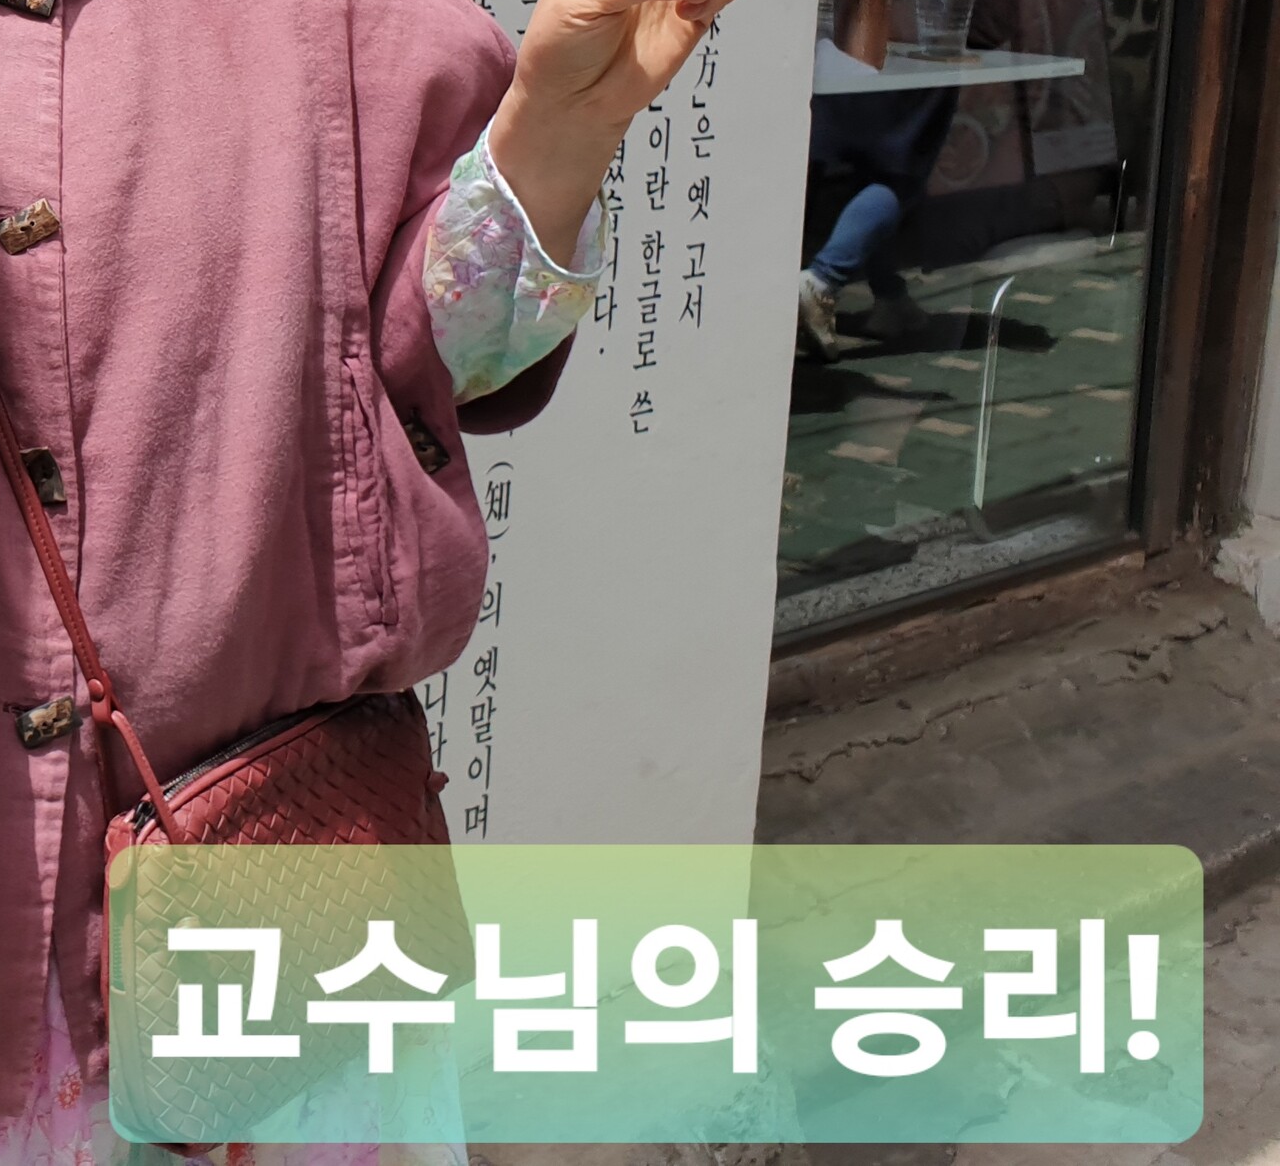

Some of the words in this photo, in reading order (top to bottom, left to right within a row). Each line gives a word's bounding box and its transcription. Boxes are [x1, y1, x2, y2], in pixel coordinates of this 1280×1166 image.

[687, 175, 710, 221] 옛
[632, 230, 665, 370] 한글로
[680, 242, 706, 329] 고서
[629, 390, 654, 434] 쓴
[464, 646, 499, 840] 옛말이며
